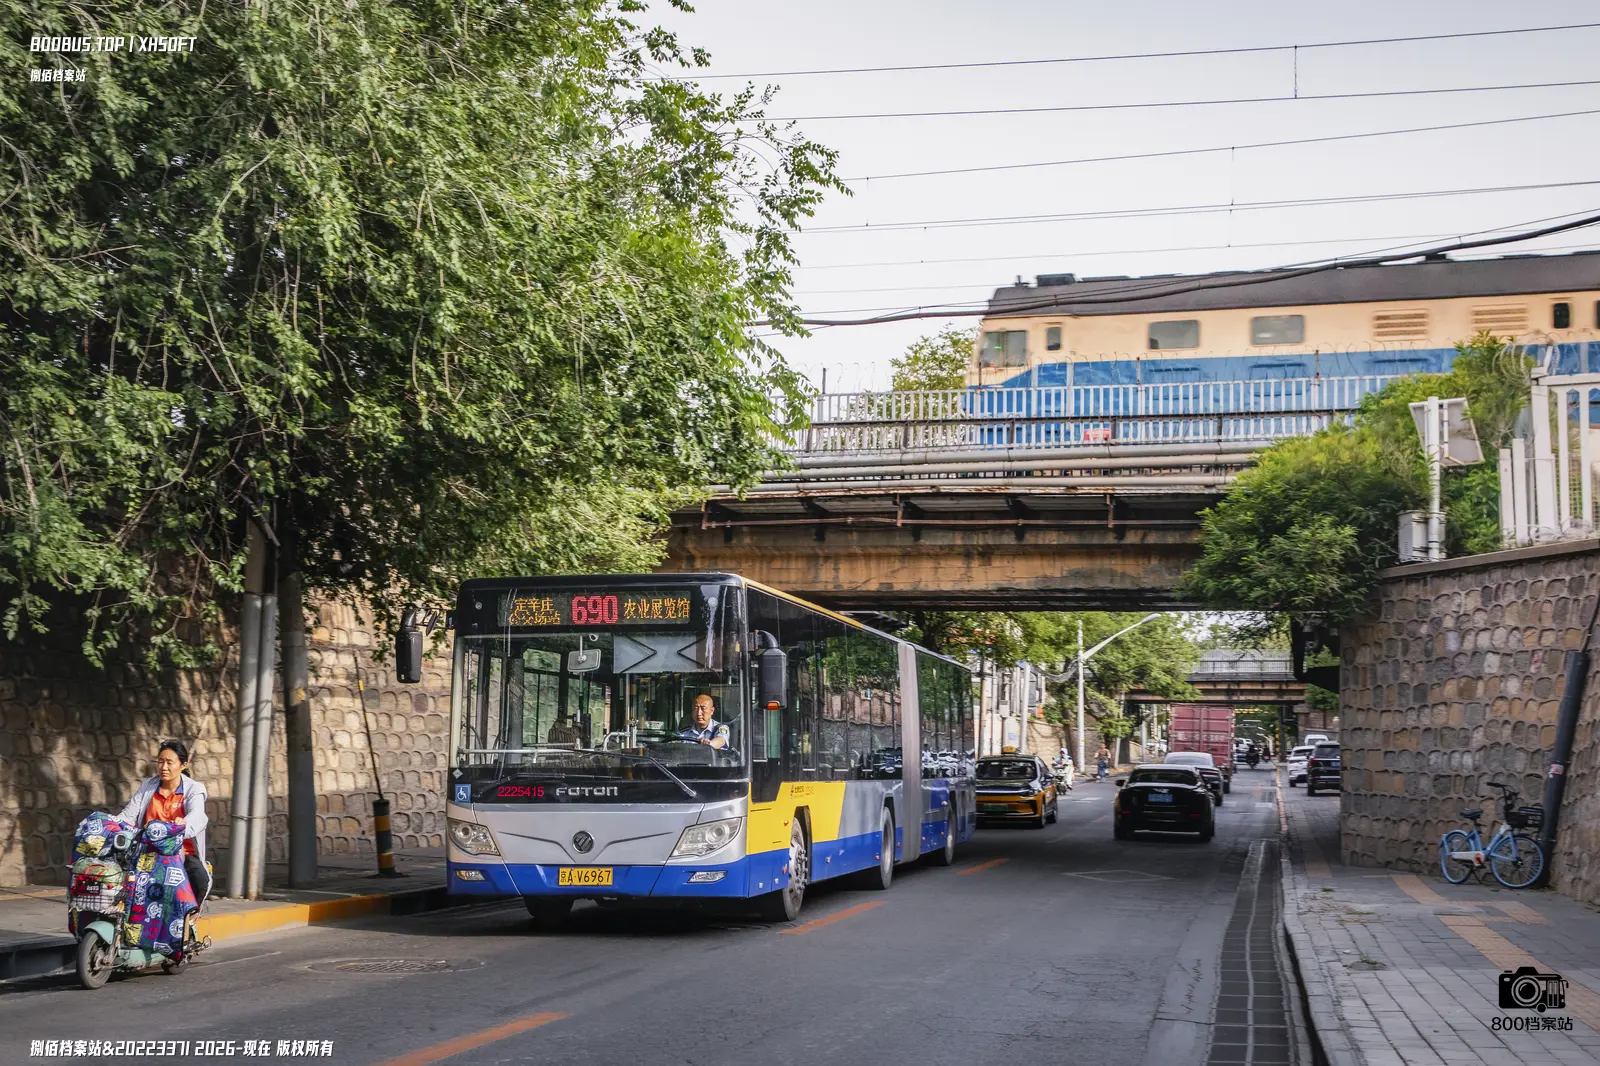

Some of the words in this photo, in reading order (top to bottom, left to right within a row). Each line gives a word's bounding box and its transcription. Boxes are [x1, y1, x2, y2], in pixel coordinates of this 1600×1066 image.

[514, 597, 554, 612] 定辛庄
[571, 595, 619, 625] 690
[623, 597, 691, 619] 农业展览馆
[507, 610, 561, 625] 公交场站
[497, 786, 545, 797] 2225415
[555, 786, 618, 797] FOTON
